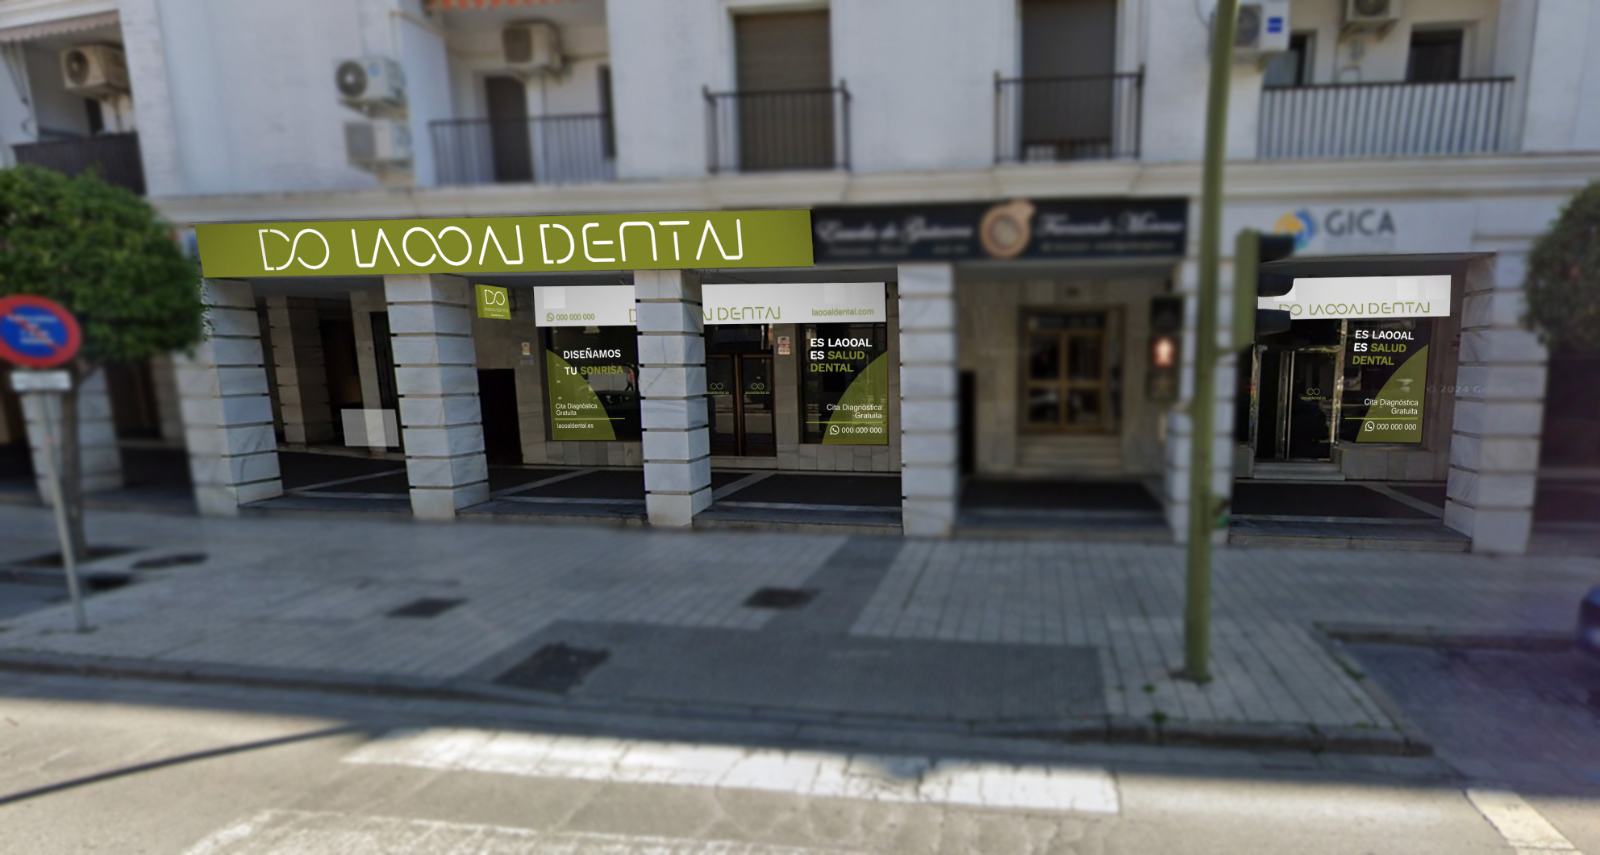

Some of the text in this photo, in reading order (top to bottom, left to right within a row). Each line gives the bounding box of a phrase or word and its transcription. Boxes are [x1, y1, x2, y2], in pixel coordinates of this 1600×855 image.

[1324, 208, 1396, 237] GICA
[258, 228, 330, 271] DO
[539, 218, 744, 265] DENTAL
[484, 289, 506, 306] DO
[1368, 301, 1431, 315] DENTAL
[556, 313, 595, 321] 000 000 000
[717, 306, 781, 321] DENTAL
[1355, 329, 1415, 341] ES LAOOAL
[810, 338, 873, 348] ES LAOOAL
[1353, 342, 1407, 353] ES SALUD
[563, 347, 622, 360] DISEÑAMOS
[810, 350, 865, 360] ES SALUD
[1352, 355, 1395, 366] DENTAL
[564, 365, 624, 376] TU SONRISA
[810, 363, 854, 373] DENTAL
[555, 402, 598, 411] Cita Diagnóstica
[826, 403, 883, 412] Cita Diagnóstica
[1364, 398, 1419, 408] Cita Diagnóstica
[854, 411, 883, 419] Gratuita
[1391, 407, 1418, 415] Gratuita
[841, 426, 883, 434] 000 000 000
[1376, 423, 1417, 431] 000 000 000
